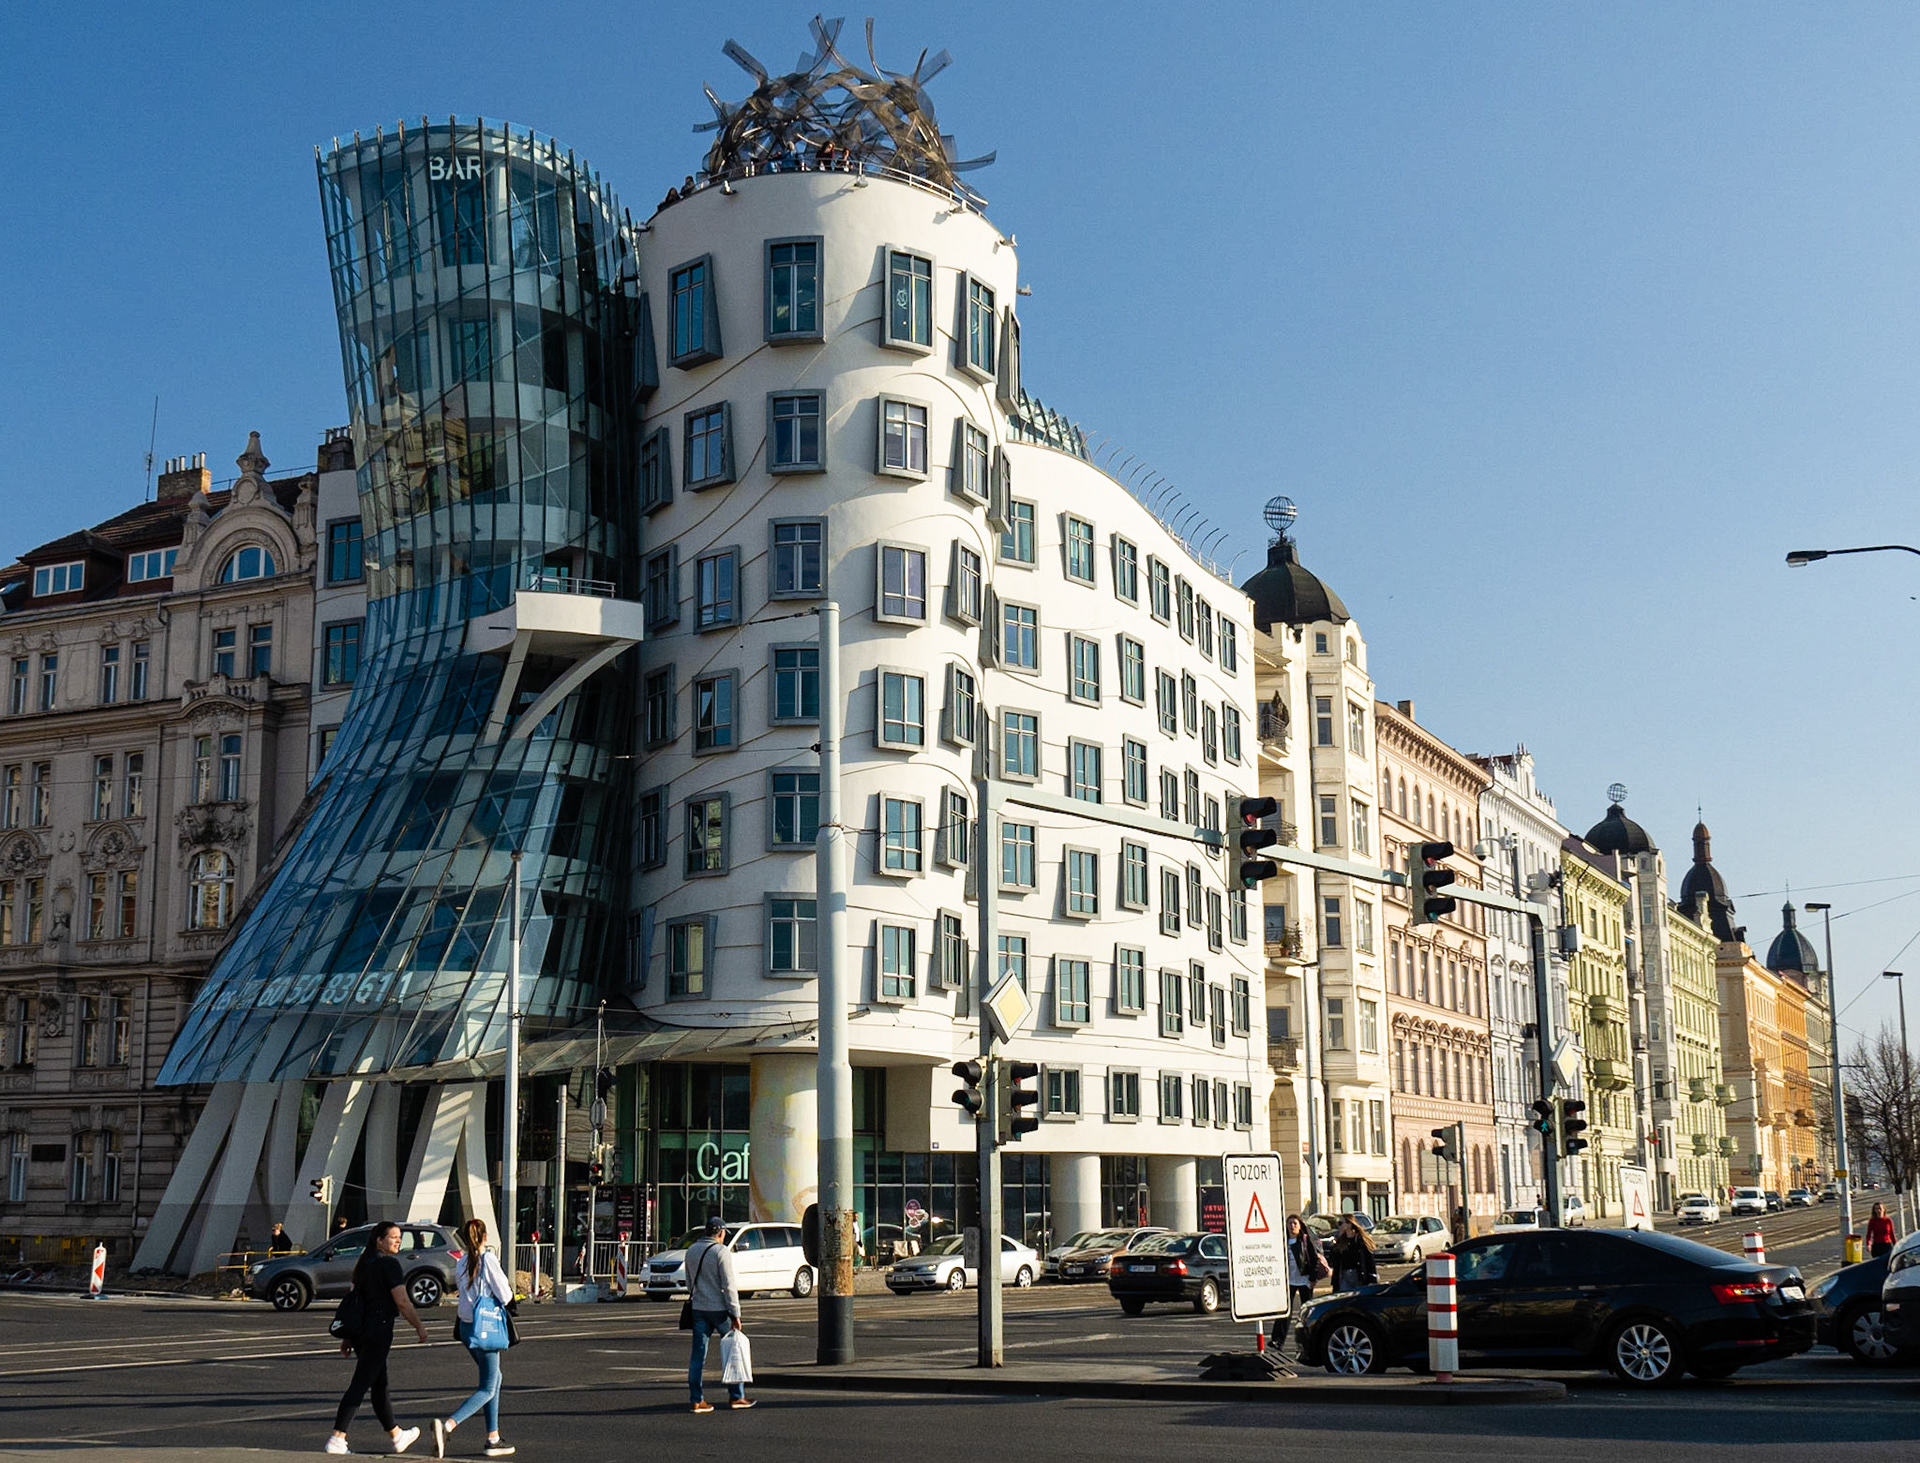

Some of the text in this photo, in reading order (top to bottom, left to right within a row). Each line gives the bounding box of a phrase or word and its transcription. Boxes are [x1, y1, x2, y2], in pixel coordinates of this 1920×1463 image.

[429, 156, 482, 180] BAR
[697, 1142, 750, 1180] Caf
[1233, 1165, 1271, 1180] POZOR!
